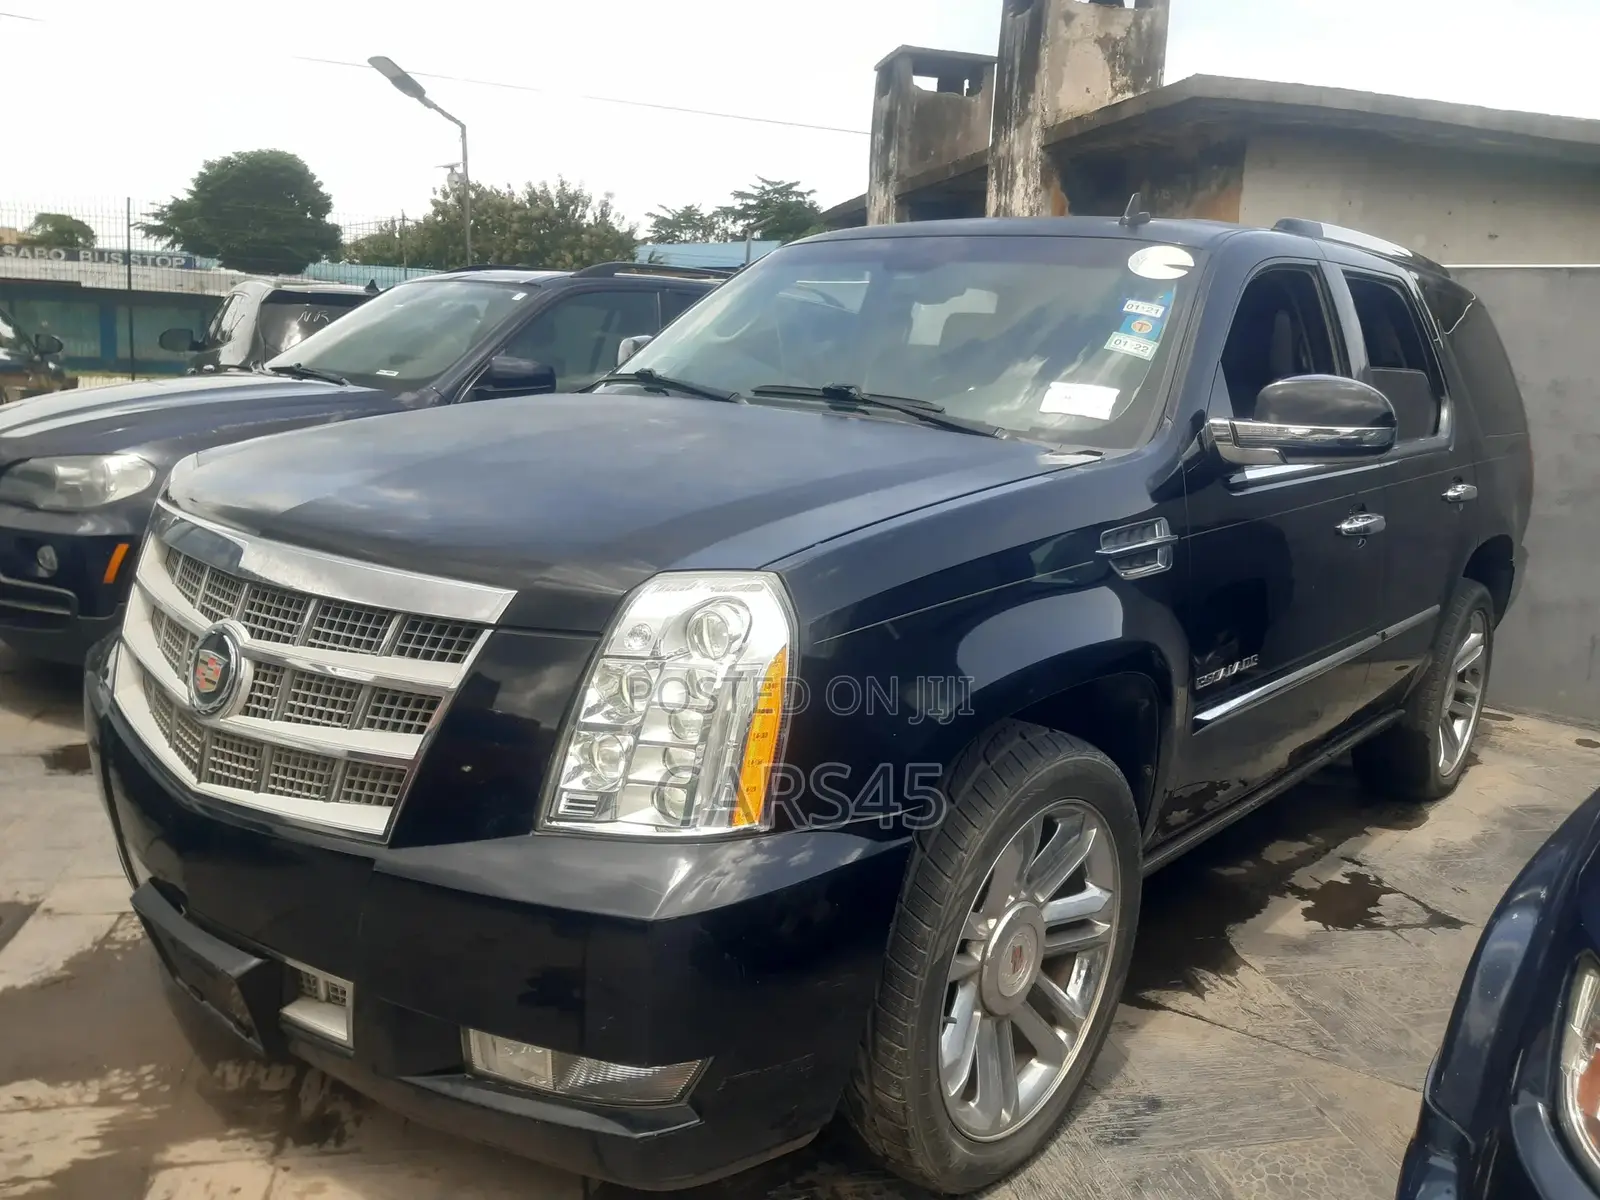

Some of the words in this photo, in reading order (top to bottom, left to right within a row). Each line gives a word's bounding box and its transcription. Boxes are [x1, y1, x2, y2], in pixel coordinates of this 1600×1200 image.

[2, 245, 67, 262] SABO
[78, 250, 124, 266] BUS
[129, 254, 187, 269] STOP
